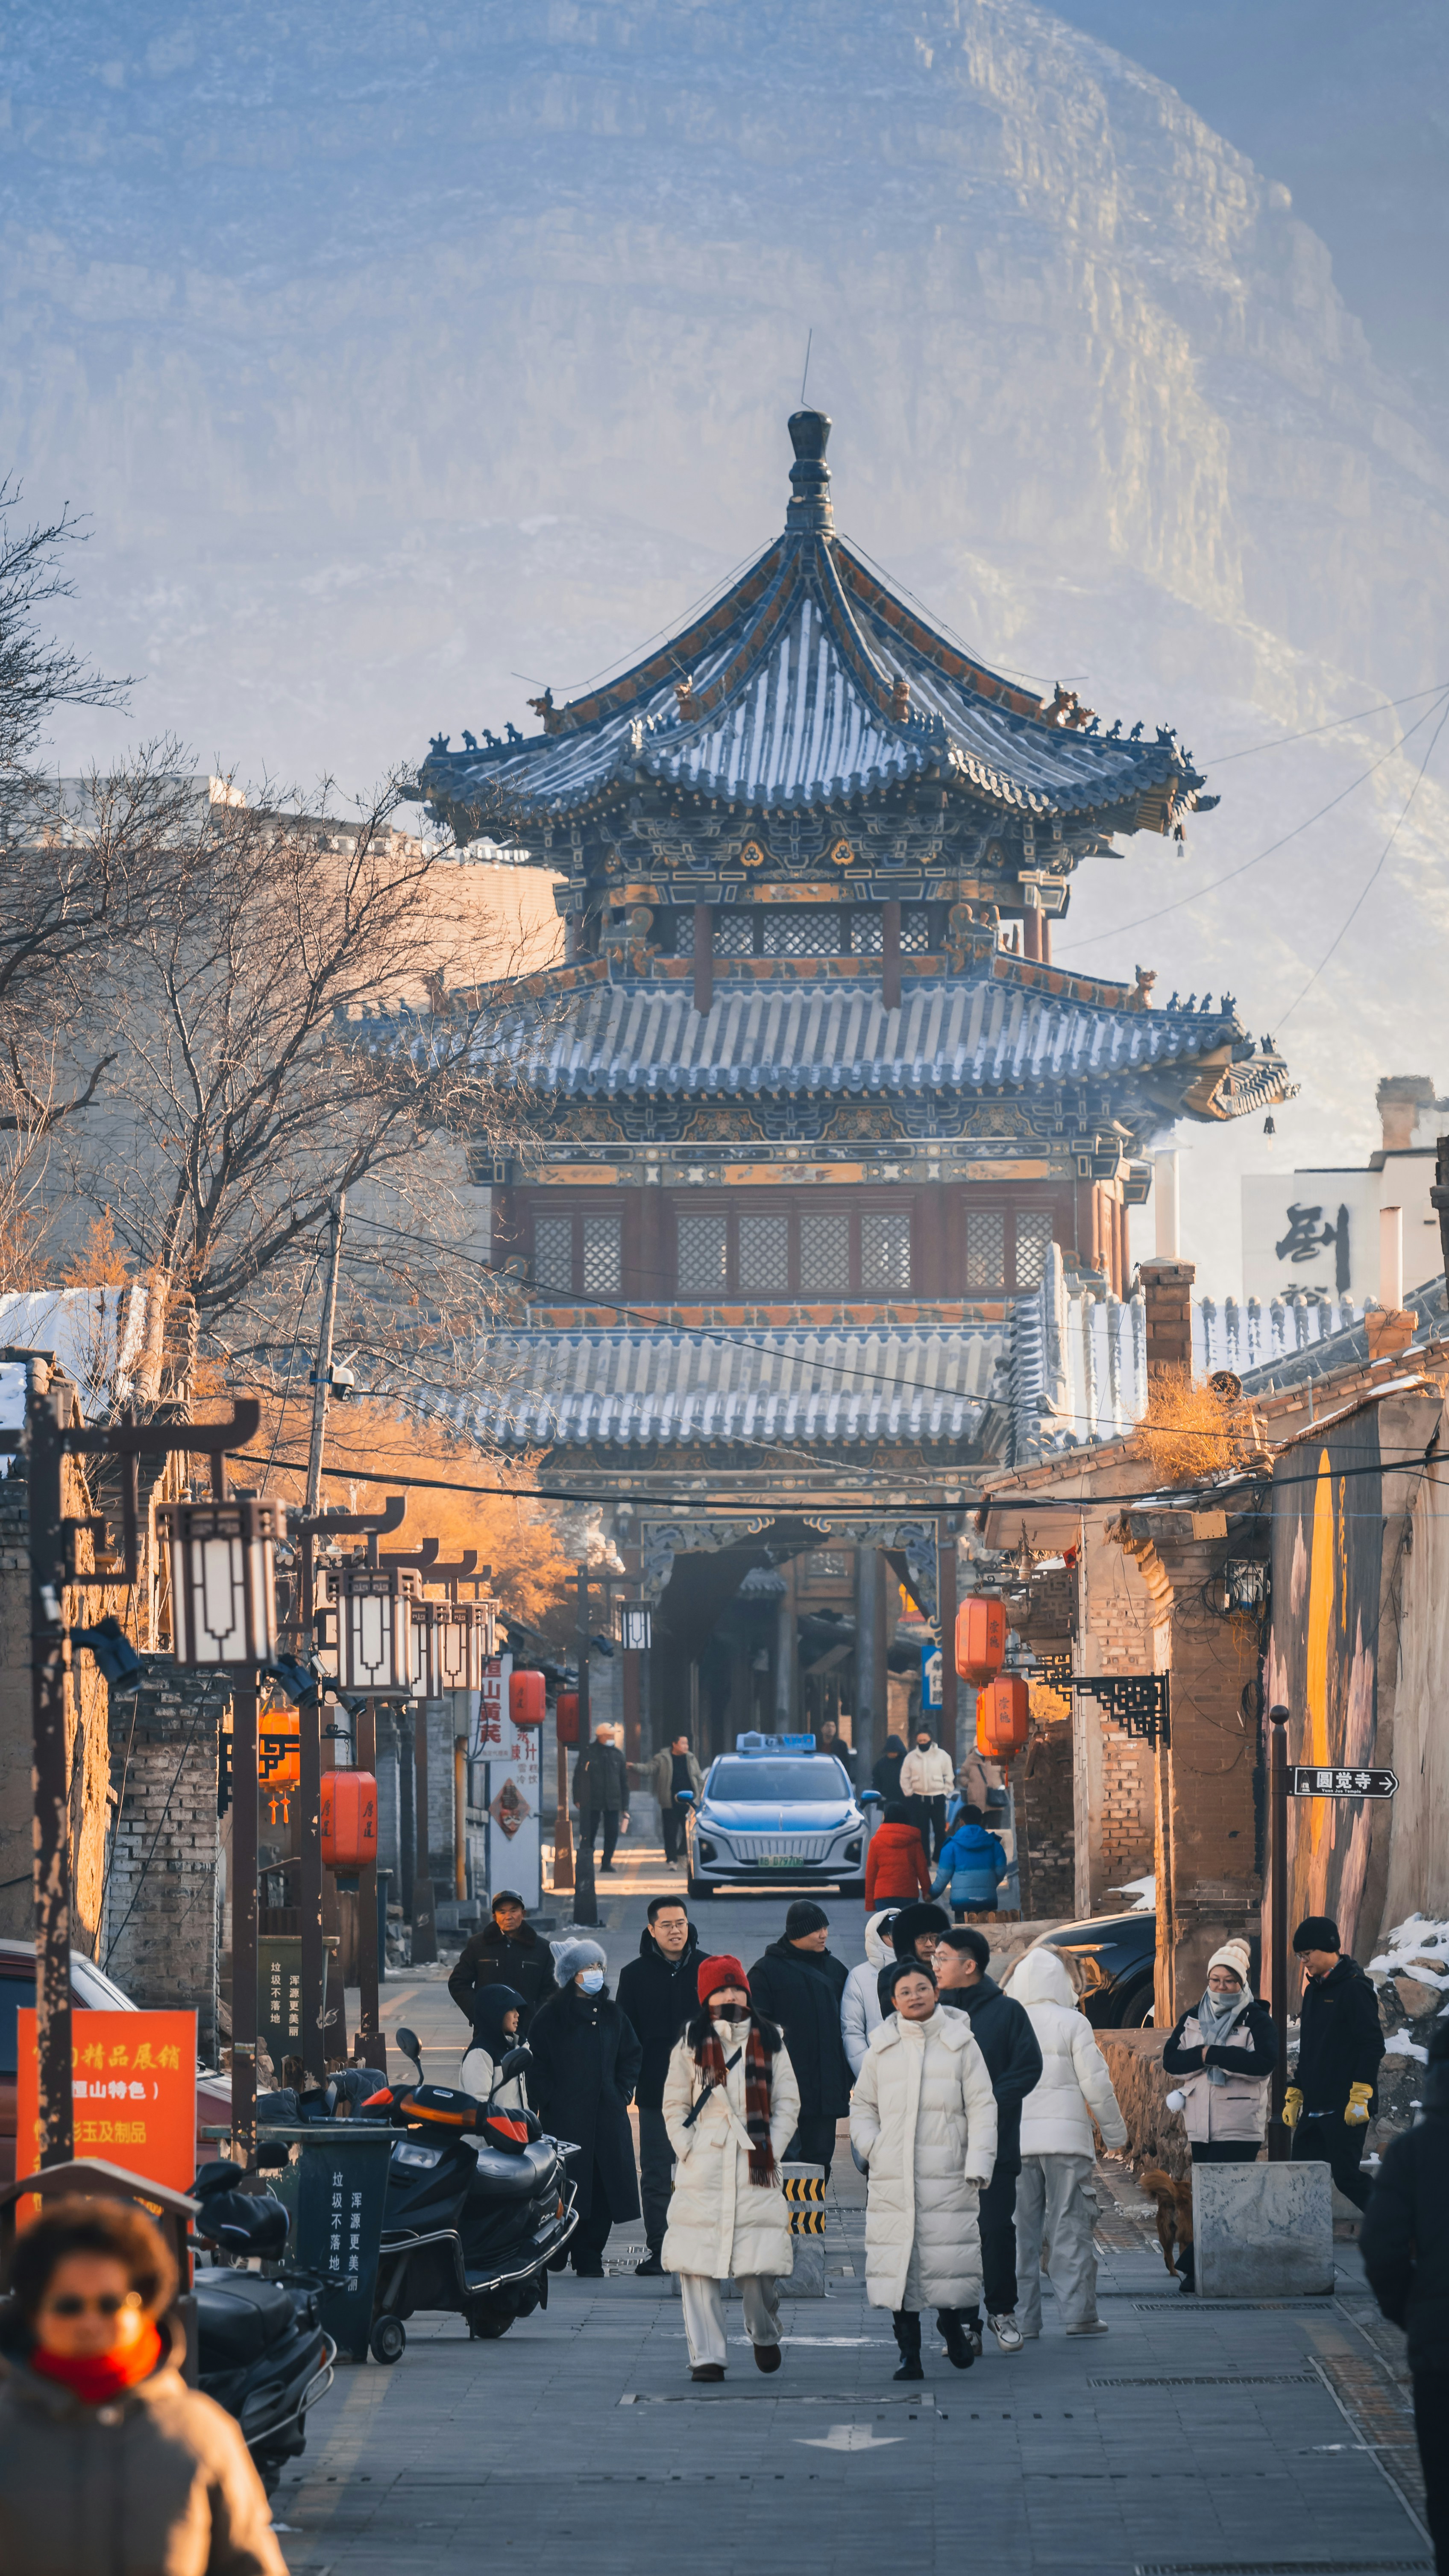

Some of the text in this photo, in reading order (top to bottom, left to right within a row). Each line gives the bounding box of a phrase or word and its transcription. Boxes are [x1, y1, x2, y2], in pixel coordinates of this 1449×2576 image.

[999, 1697, 1011, 1723] 崇德
[1317, 1771, 1371, 1790] 圆觉寺
[270, 1962, 281, 2024] 垃圾不落地
[289, 1975, 300, 2037] 浑源更美丽
[329, 2172, 343, 2271] 垃圾不落地
[348, 2192, 362, 2292] 浑源更美丽
